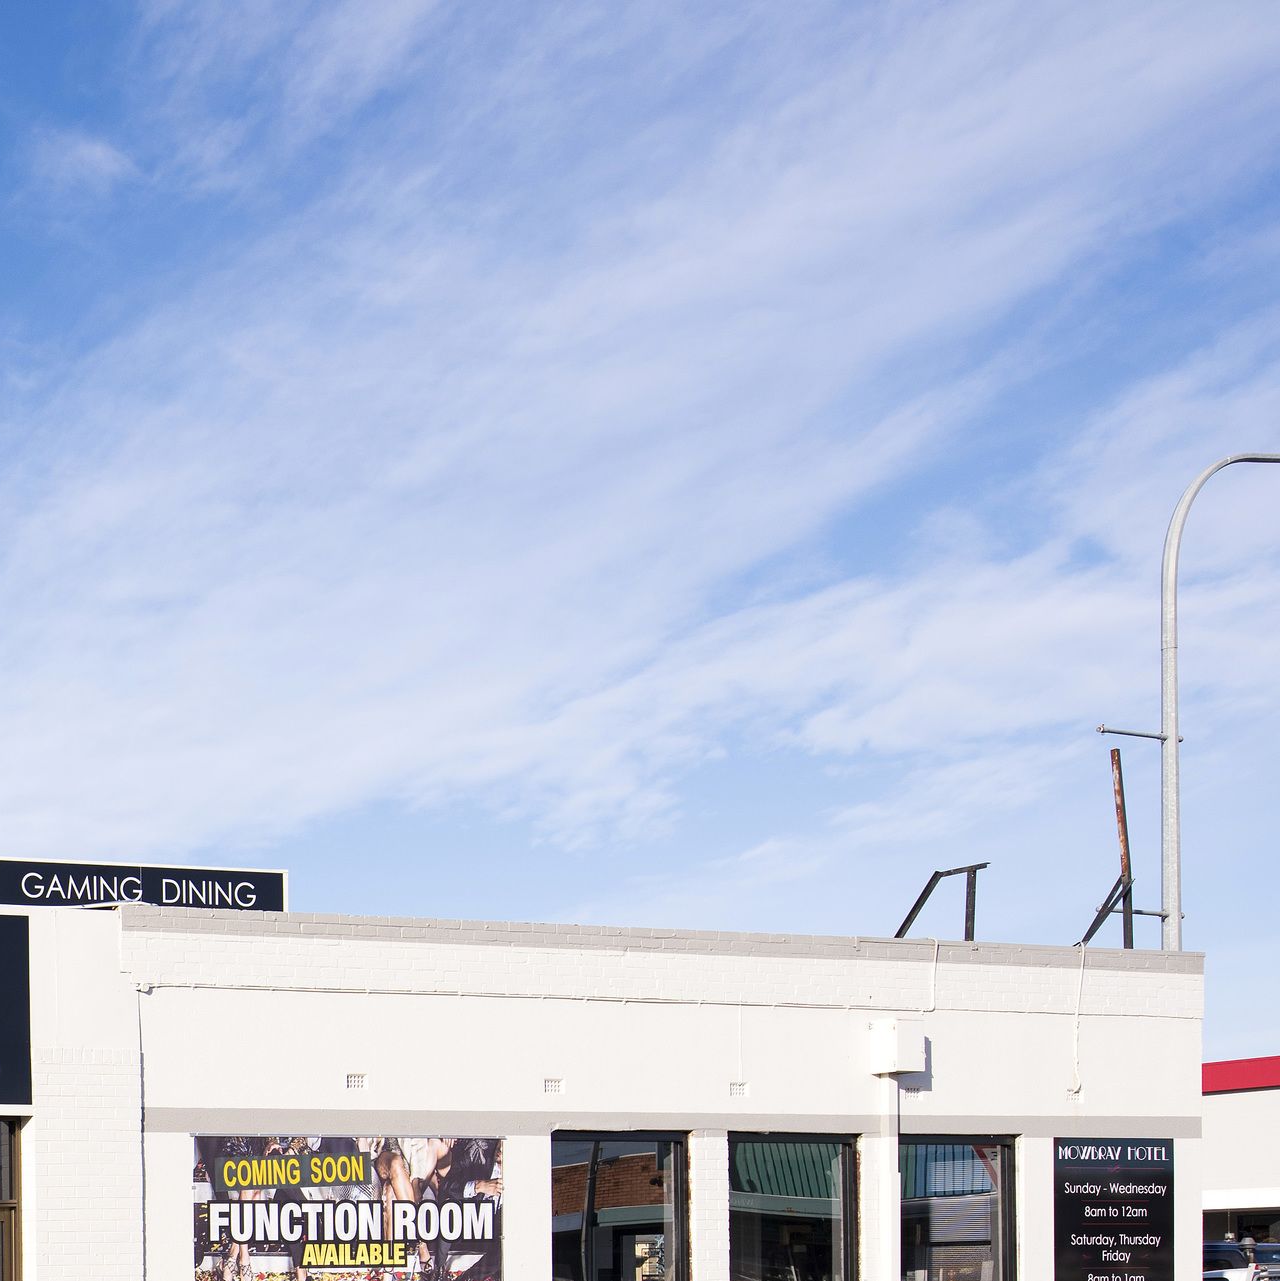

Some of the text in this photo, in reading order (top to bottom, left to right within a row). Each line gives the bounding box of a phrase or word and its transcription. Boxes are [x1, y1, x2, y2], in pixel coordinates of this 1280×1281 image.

[21, 872, 257, 908] GAMING DINING
[1058, 1145, 1170, 1161] MOWBRAY HOTEL
[223, 1156, 365, 1187] COMING SOON
[1064, 1182, 1102, 1196] Sunday
[1109, 1182, 1167, 1196] Wednesday
[1084, 1205, 1148, 1218] 8am to 12am
[208, 1202, 493, 1242] FUNCTION ROOM
[1070, 1233, 1162, 1248] Saturday, Thursday
[302, 1243, 407, 1267] AVAILABLE
[1102, 1249, 1132, 1264] Friday
